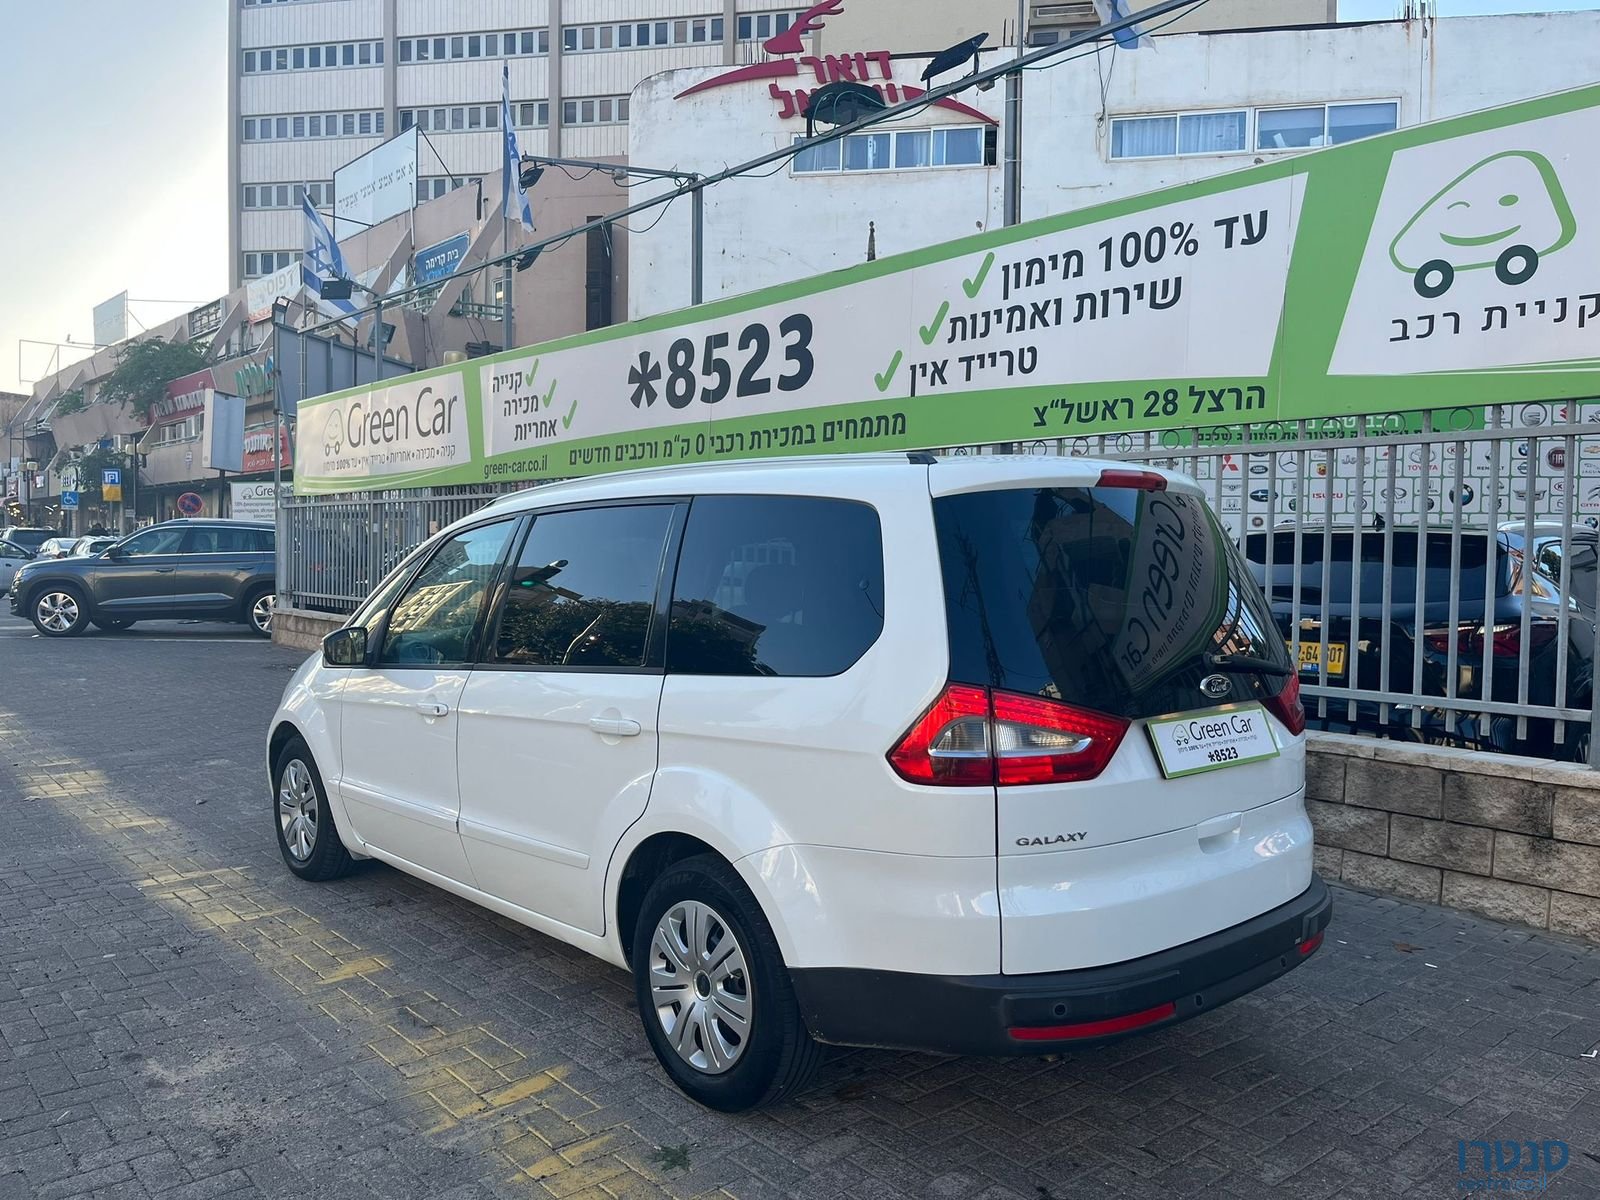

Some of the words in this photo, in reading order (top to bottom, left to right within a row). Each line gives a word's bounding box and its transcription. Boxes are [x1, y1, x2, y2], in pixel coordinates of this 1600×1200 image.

[800, 51, 893, 84] דואר
[1214, 209, 1269, 249] עד
[447, 249, 459, 262] בית
[1099, 221, 1199, 272] 100%
[425, 253, 446, 270] קדימה
[1001, 249, 1084, 300] מימון
[1073, 276, 1183, 323] שירות
[1481, 293, 1600, 331] קניית
[947, 297, 1062, 344] ואמינות
[1389, 311, 1460, 342] רכב
[958, 345, 1038, 382] טרייד
[492, 371, 523, 394] קנייה
[909, 359, 949, 397] אין
[503, 395, 539, 417] מכירה
[1144, 388, 1178, 417] 28
[1189, 385, 1266, 414] הרצל
[347, 402, 409, 448] Green
[415, 386, 457, 438] Car
[514, 419, 558, 442] אחריות
[822, 412, 906, 442] מתמחים
[709, 431, 745, 454] רכבי
[748, 423, 816, 450] במכירת
[416, 447, 435, 460] מכירה
[440, 445, 455, 460] קניה
[569, 445, 611, 466] חדשים
[615, 441, 657, 462] ורכבים
[484, 455, 548, 479] green-car.co.il
[1189, 721, 1231, 741] Green
[1230, 715, 1253, 734] Car
[1015, 831, 1088, 846] GALAXY
